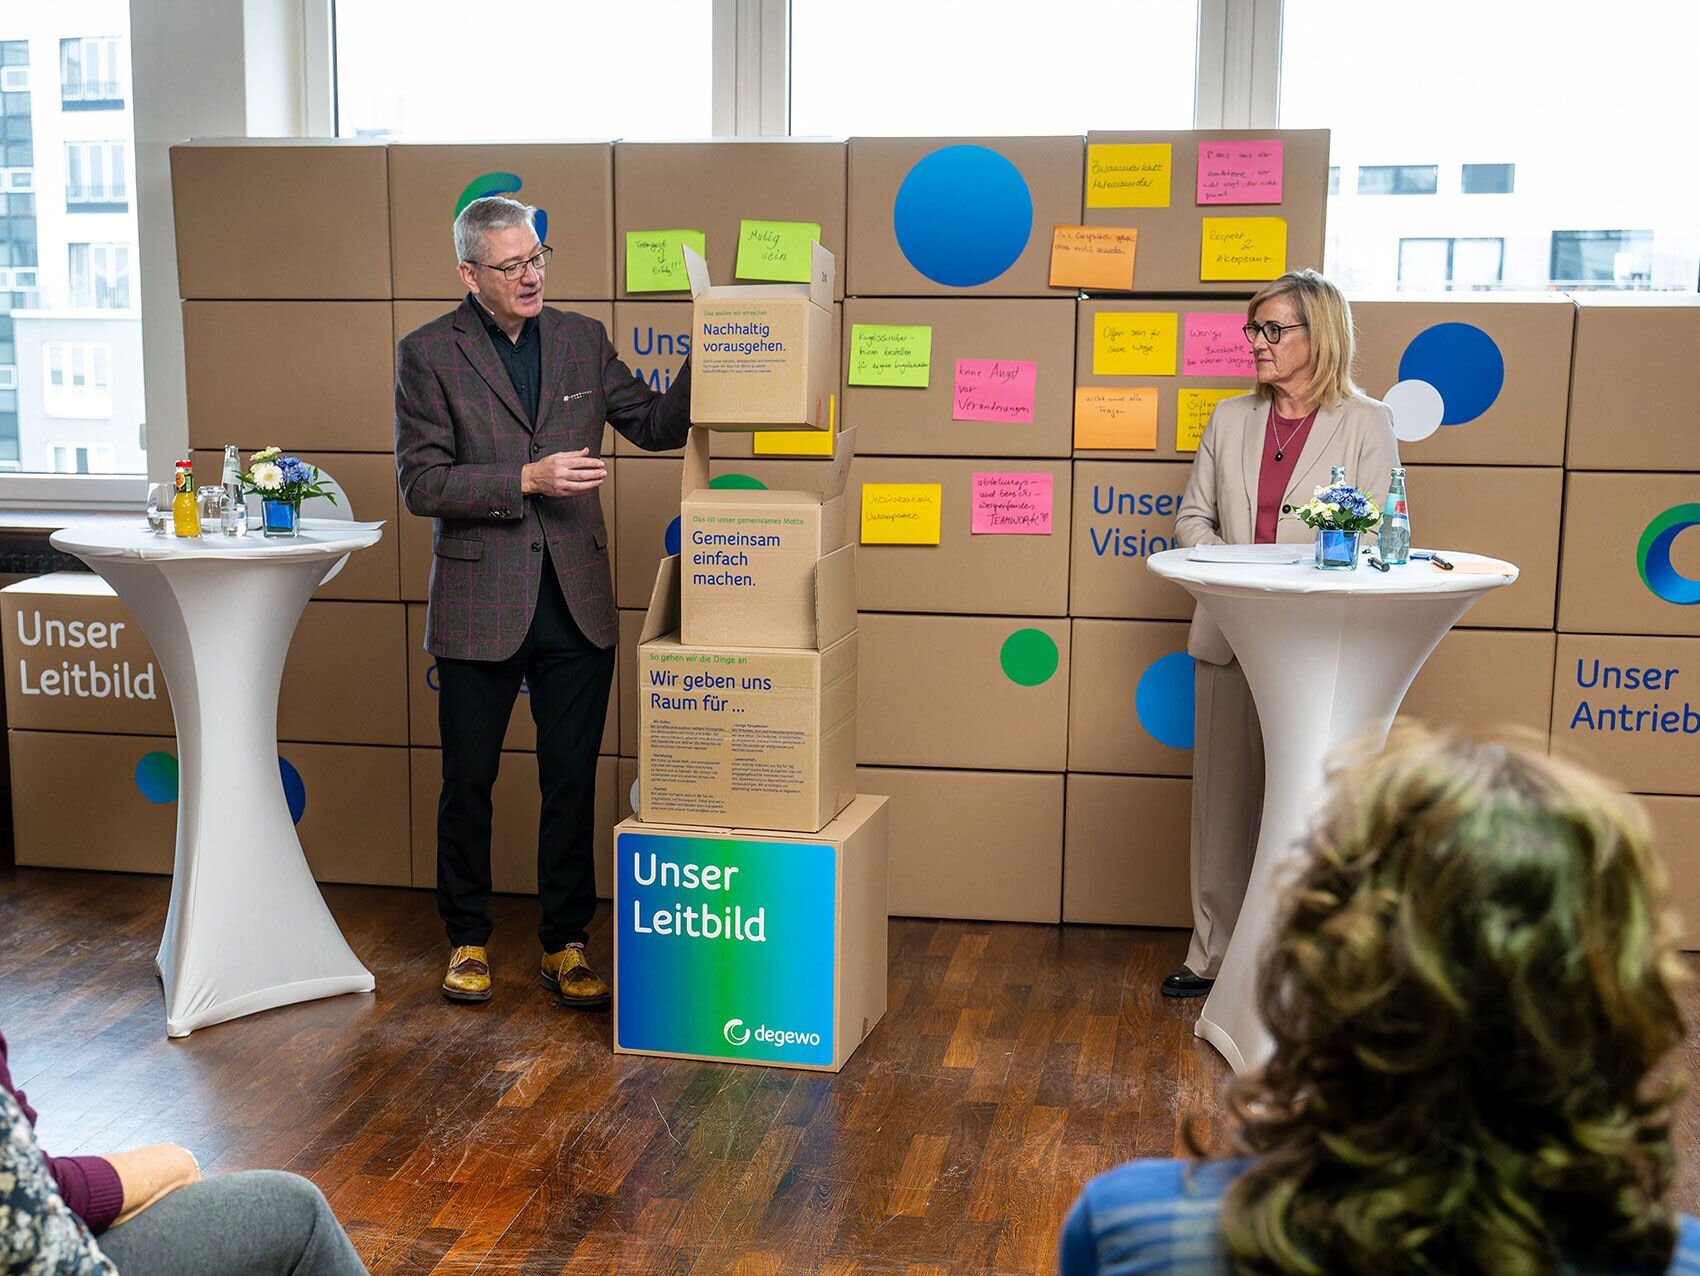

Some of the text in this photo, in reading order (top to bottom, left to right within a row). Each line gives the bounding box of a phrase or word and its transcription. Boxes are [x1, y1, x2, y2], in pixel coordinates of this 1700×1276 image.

[748, 230, 780, 249] Mutig
[762, 249, 788, 261] sein
[703, 322, 770, 338] Nachhaltig
[633, 327, 692, 356] Uns
[703, 339, 786, 355] vorausgehen.
[1093, 485, 1184, 516] Unser
[737, 517, 782, 525] gemeinsames
[783, 517, 805, 525] Motto
[986, 512, 1039, 527] TEAMWORK
[692, 530, 780, 547] Gemeinsam
[1090, 527, 1177, 557] Visio
[693, 551, 748, 566] einfach
[693, 571, 756, 586] machen.
[17, 609, 125, 649] Unser
[650, 653, 659, 661] So
[659, 653, 684, 663] gehen
[686, 654, 699, 662] wir
[700, 654, 712, 663] die
[713, 655, 736, 665] Dinge
[19, 659, 157, 700] Leitbild
[650, 670, 772, 692] Wir geben uns
[1577, 658, 1680, 690] Unser
[651, 692, 698, 711] Raum
[703, 694, 729, 712] für
[1570, 701, 1700, 734] Antrieb
[634, 852, 739, 891] Unser
[634, 900, 766, 942] Leitbild
[754, 1024, 821, 1047] degewo
